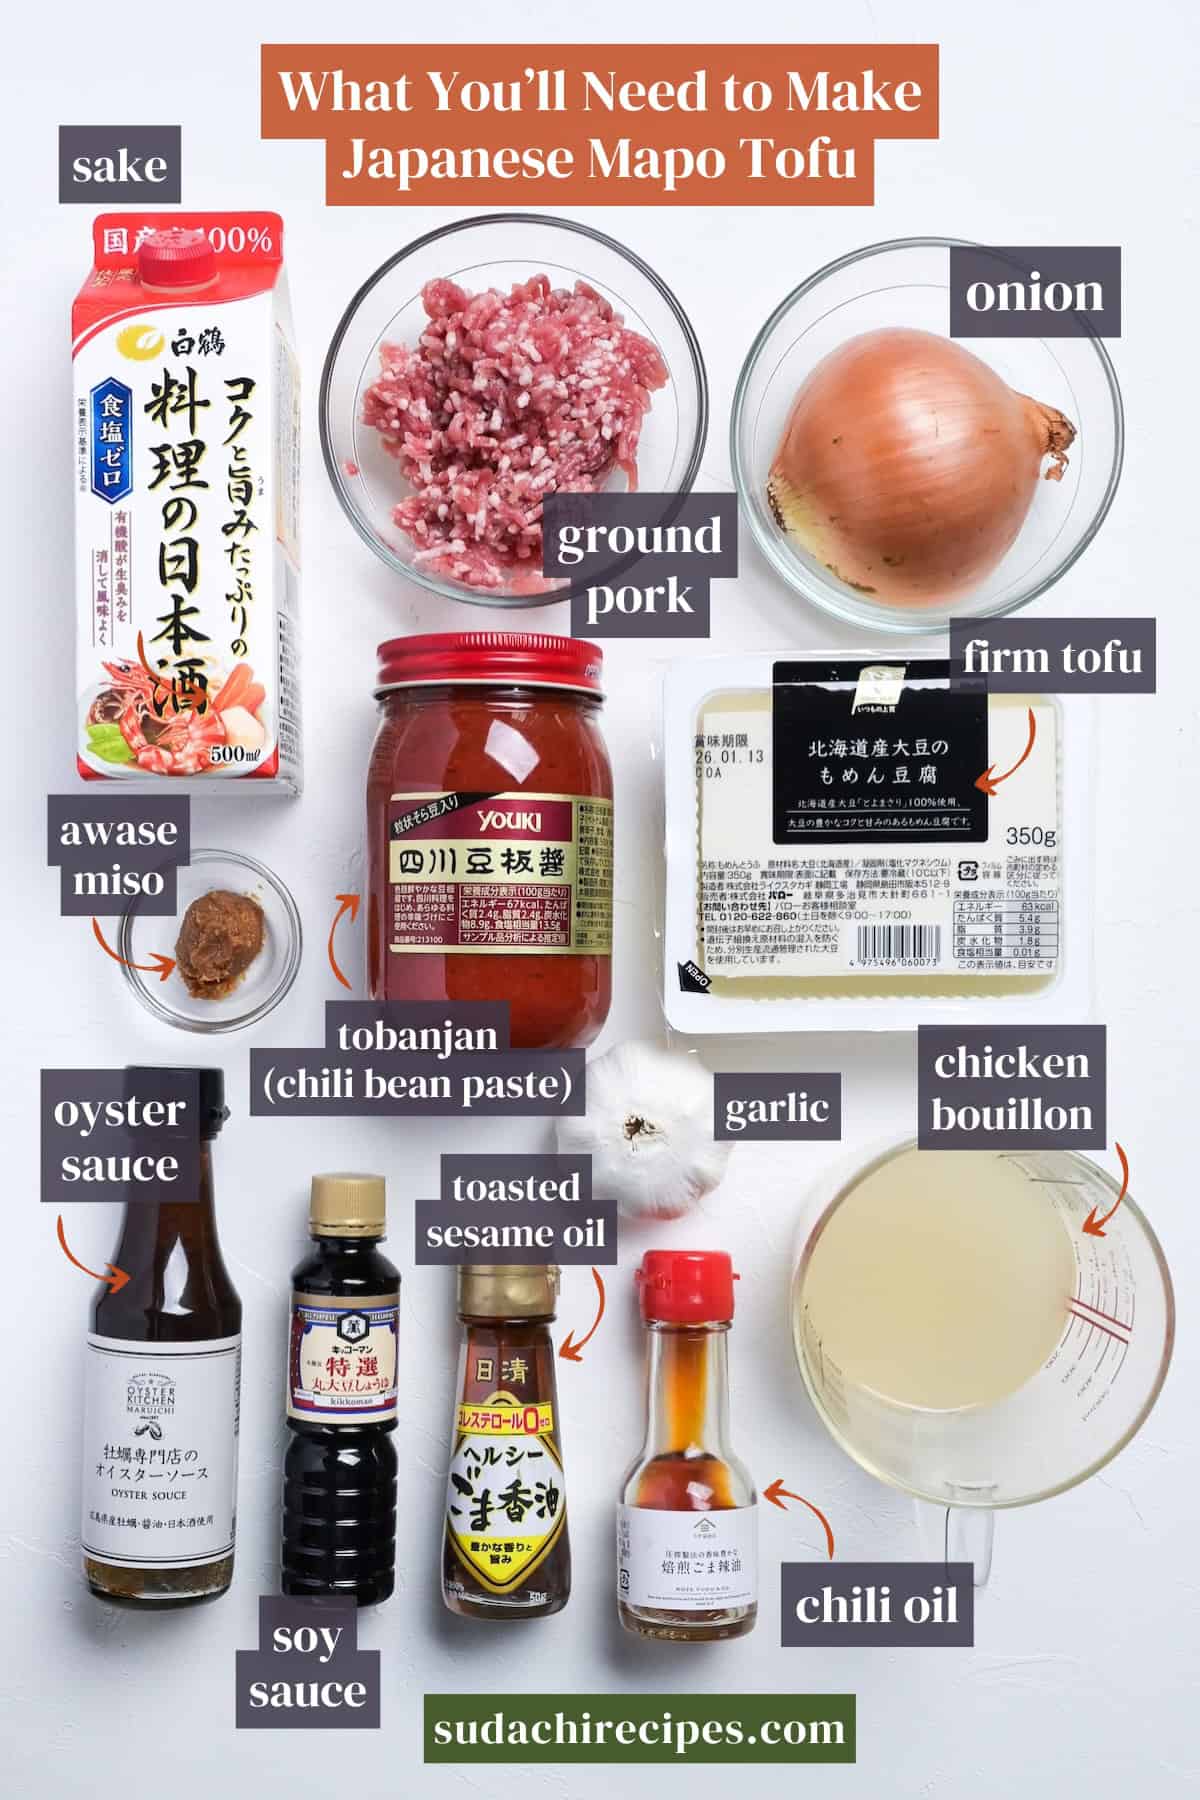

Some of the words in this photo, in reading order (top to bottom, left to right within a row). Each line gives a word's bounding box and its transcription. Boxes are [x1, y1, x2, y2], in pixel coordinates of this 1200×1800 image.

[171, 326, 226, 357] 白鶴
[100, 393, 124, 487] 食塩ゼロ
[222, 377, 257, 656] コクと旨みたっぷりの
[144, 365, 211, 716] 料理の日本酒
[115, 510, 128, 622] 有機酸が生臭みを
[96, 549, 109, 646] 消して風味よく
[808, 738, 948, 758] 北海道産大豆の
[820, 766, 937, 784] もめん豆腐
[393, 794, 459, 833] 粒状そら豆入り
[1006, 827, 1056, 847] 350g
[326, 1356, 378, 1377] 特選
[476, 1358, 529, 1384] 日清
[127, 1386, 175, 1396] OYSTER
[127, 1395, 175, 1405] KITCHEN
[464, 1446, 544, 1467] ヘルシー
[96, 1464, 208, 1482] オイスターソース
[111, 1488, 147, 1500] OYSTER
[152, 1491, 188, 1501] SOUCE
[451, 1466, 560, 1532] ごま香油
[470, 1542, 533, 1552] 豊かな香りと
[662, 1559, 741, 1575] 焙煎ごま辣油
